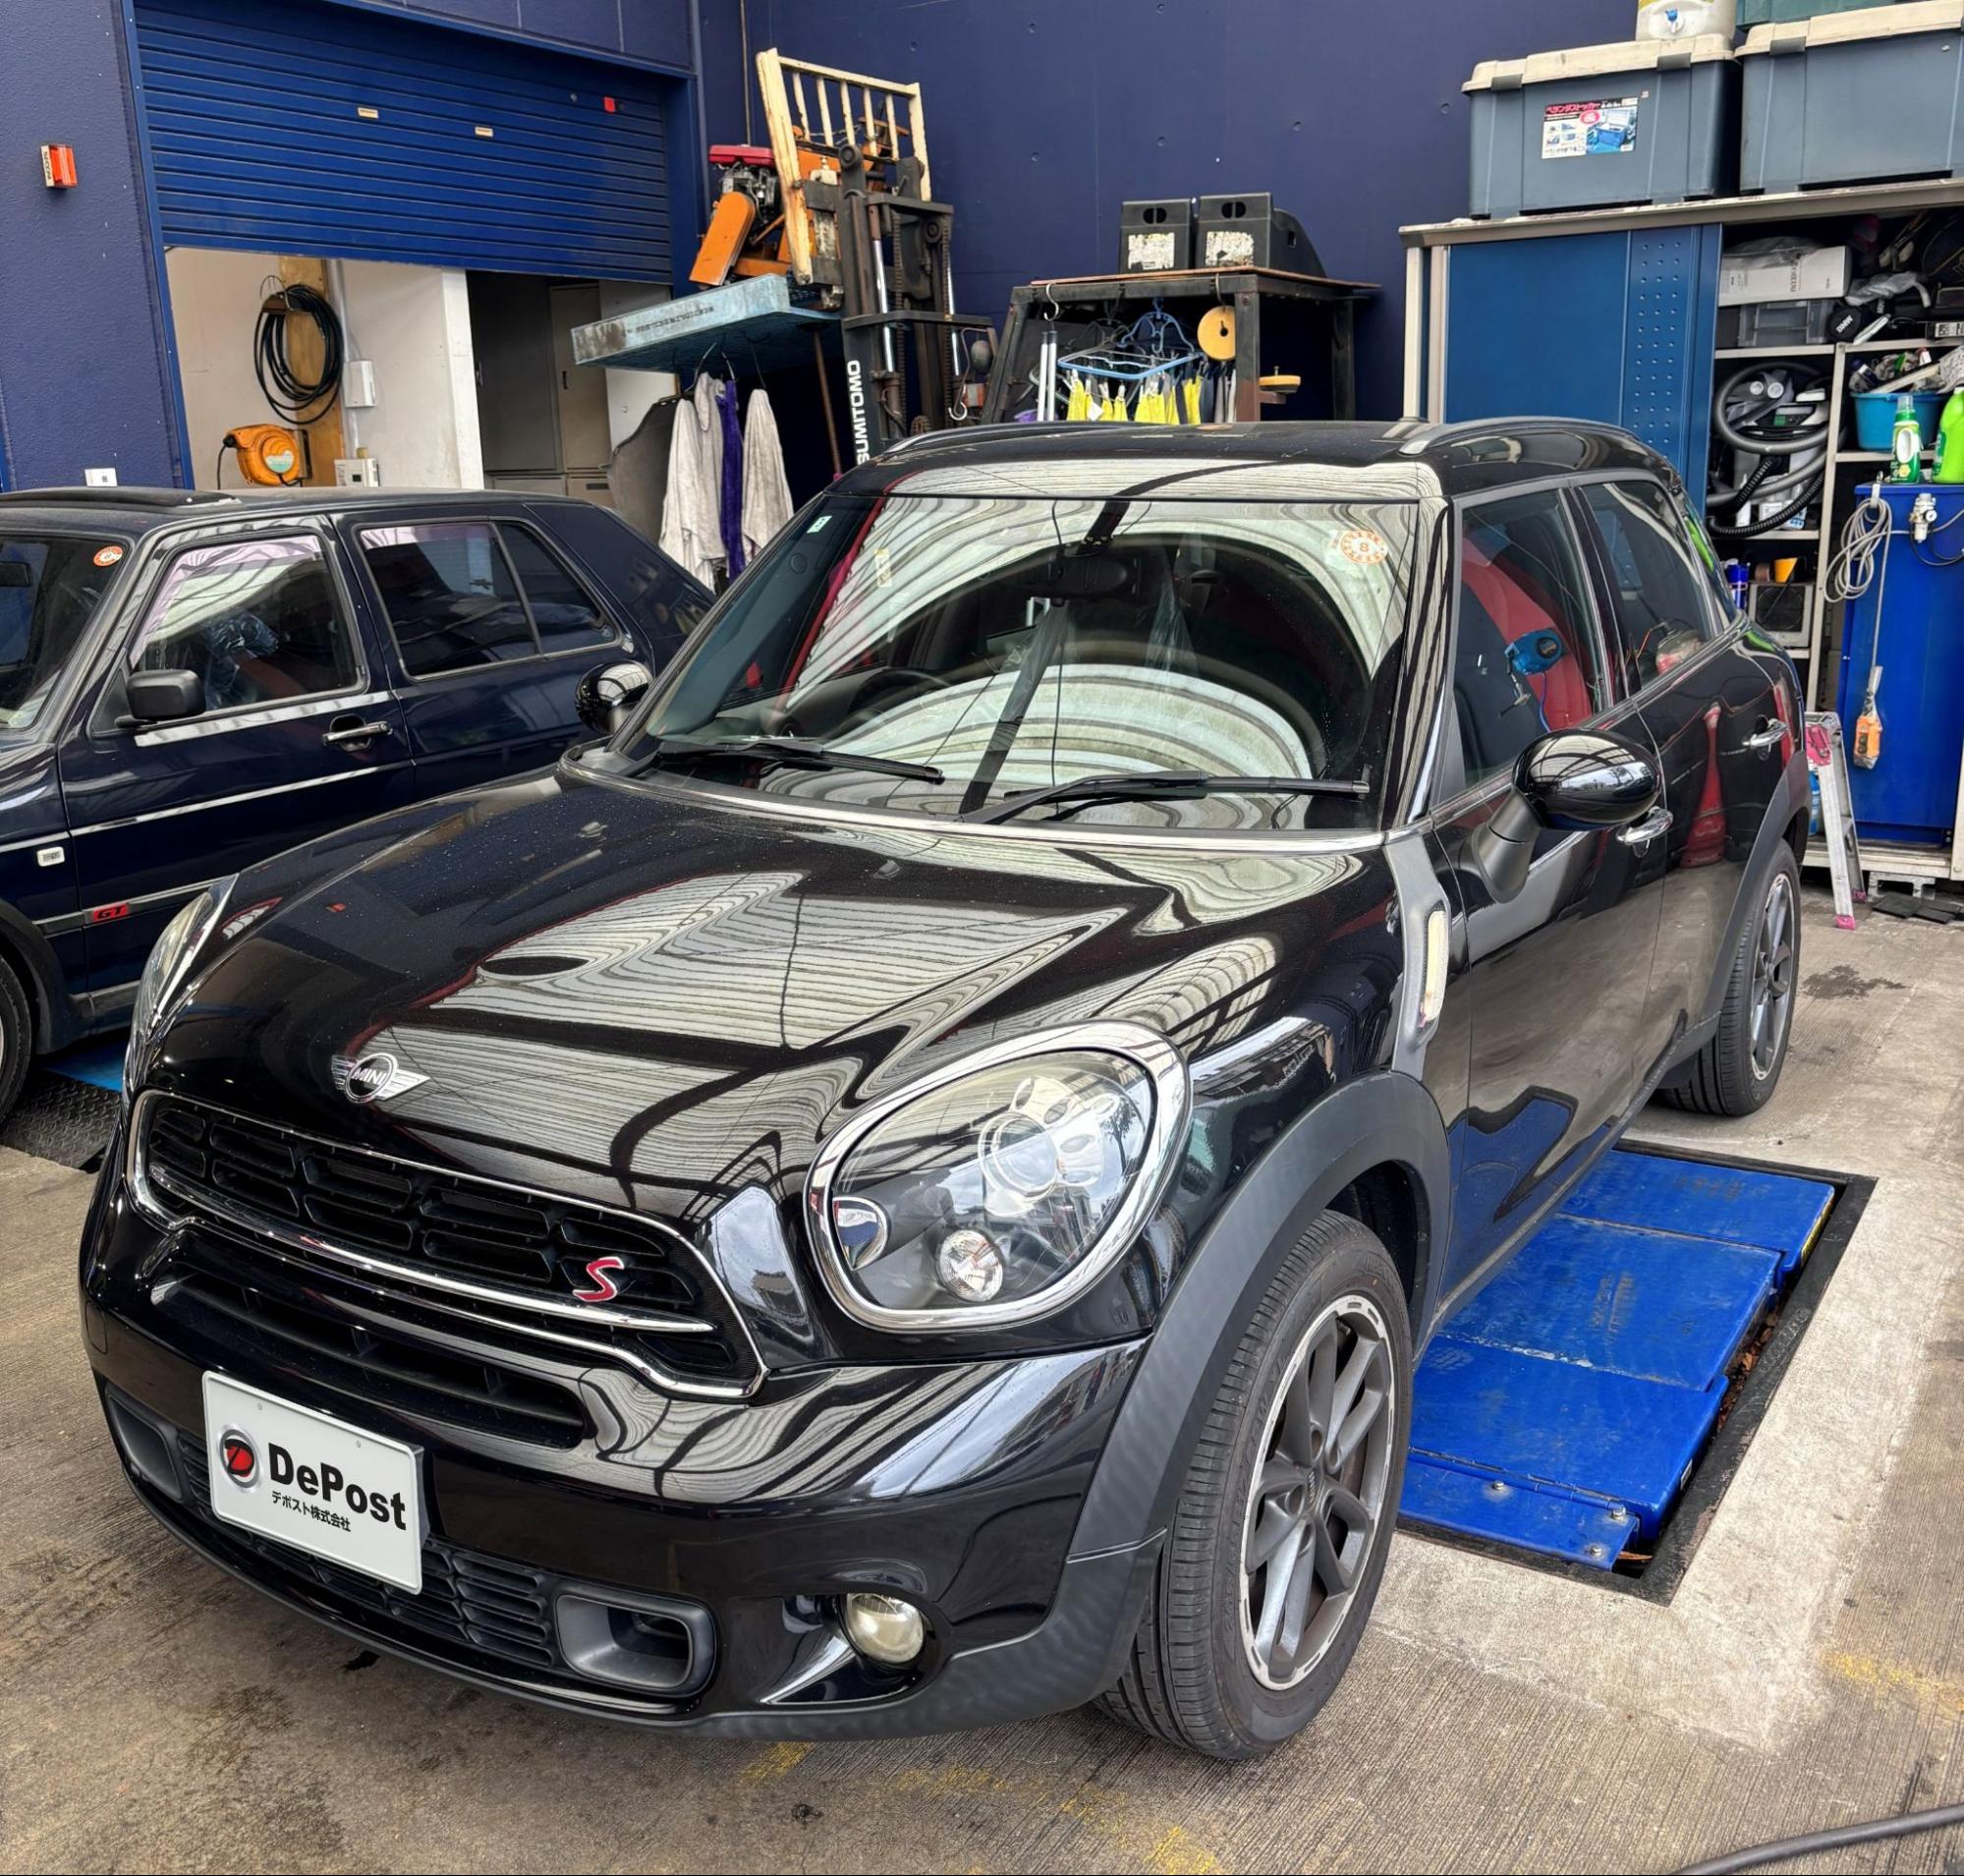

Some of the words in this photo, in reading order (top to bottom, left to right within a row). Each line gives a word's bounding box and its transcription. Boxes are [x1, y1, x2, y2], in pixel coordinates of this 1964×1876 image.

[1835, 314, 1854, 333] BMW
[847, 360, 870, 466] SUMITOMO
[351, 1067, 389, 1086] MINI
[572, 1256, 625, 1302] S
[267, 1442, 407, 1531] DePost
[271, 1490, 352, 1533] デポスト株式会社
